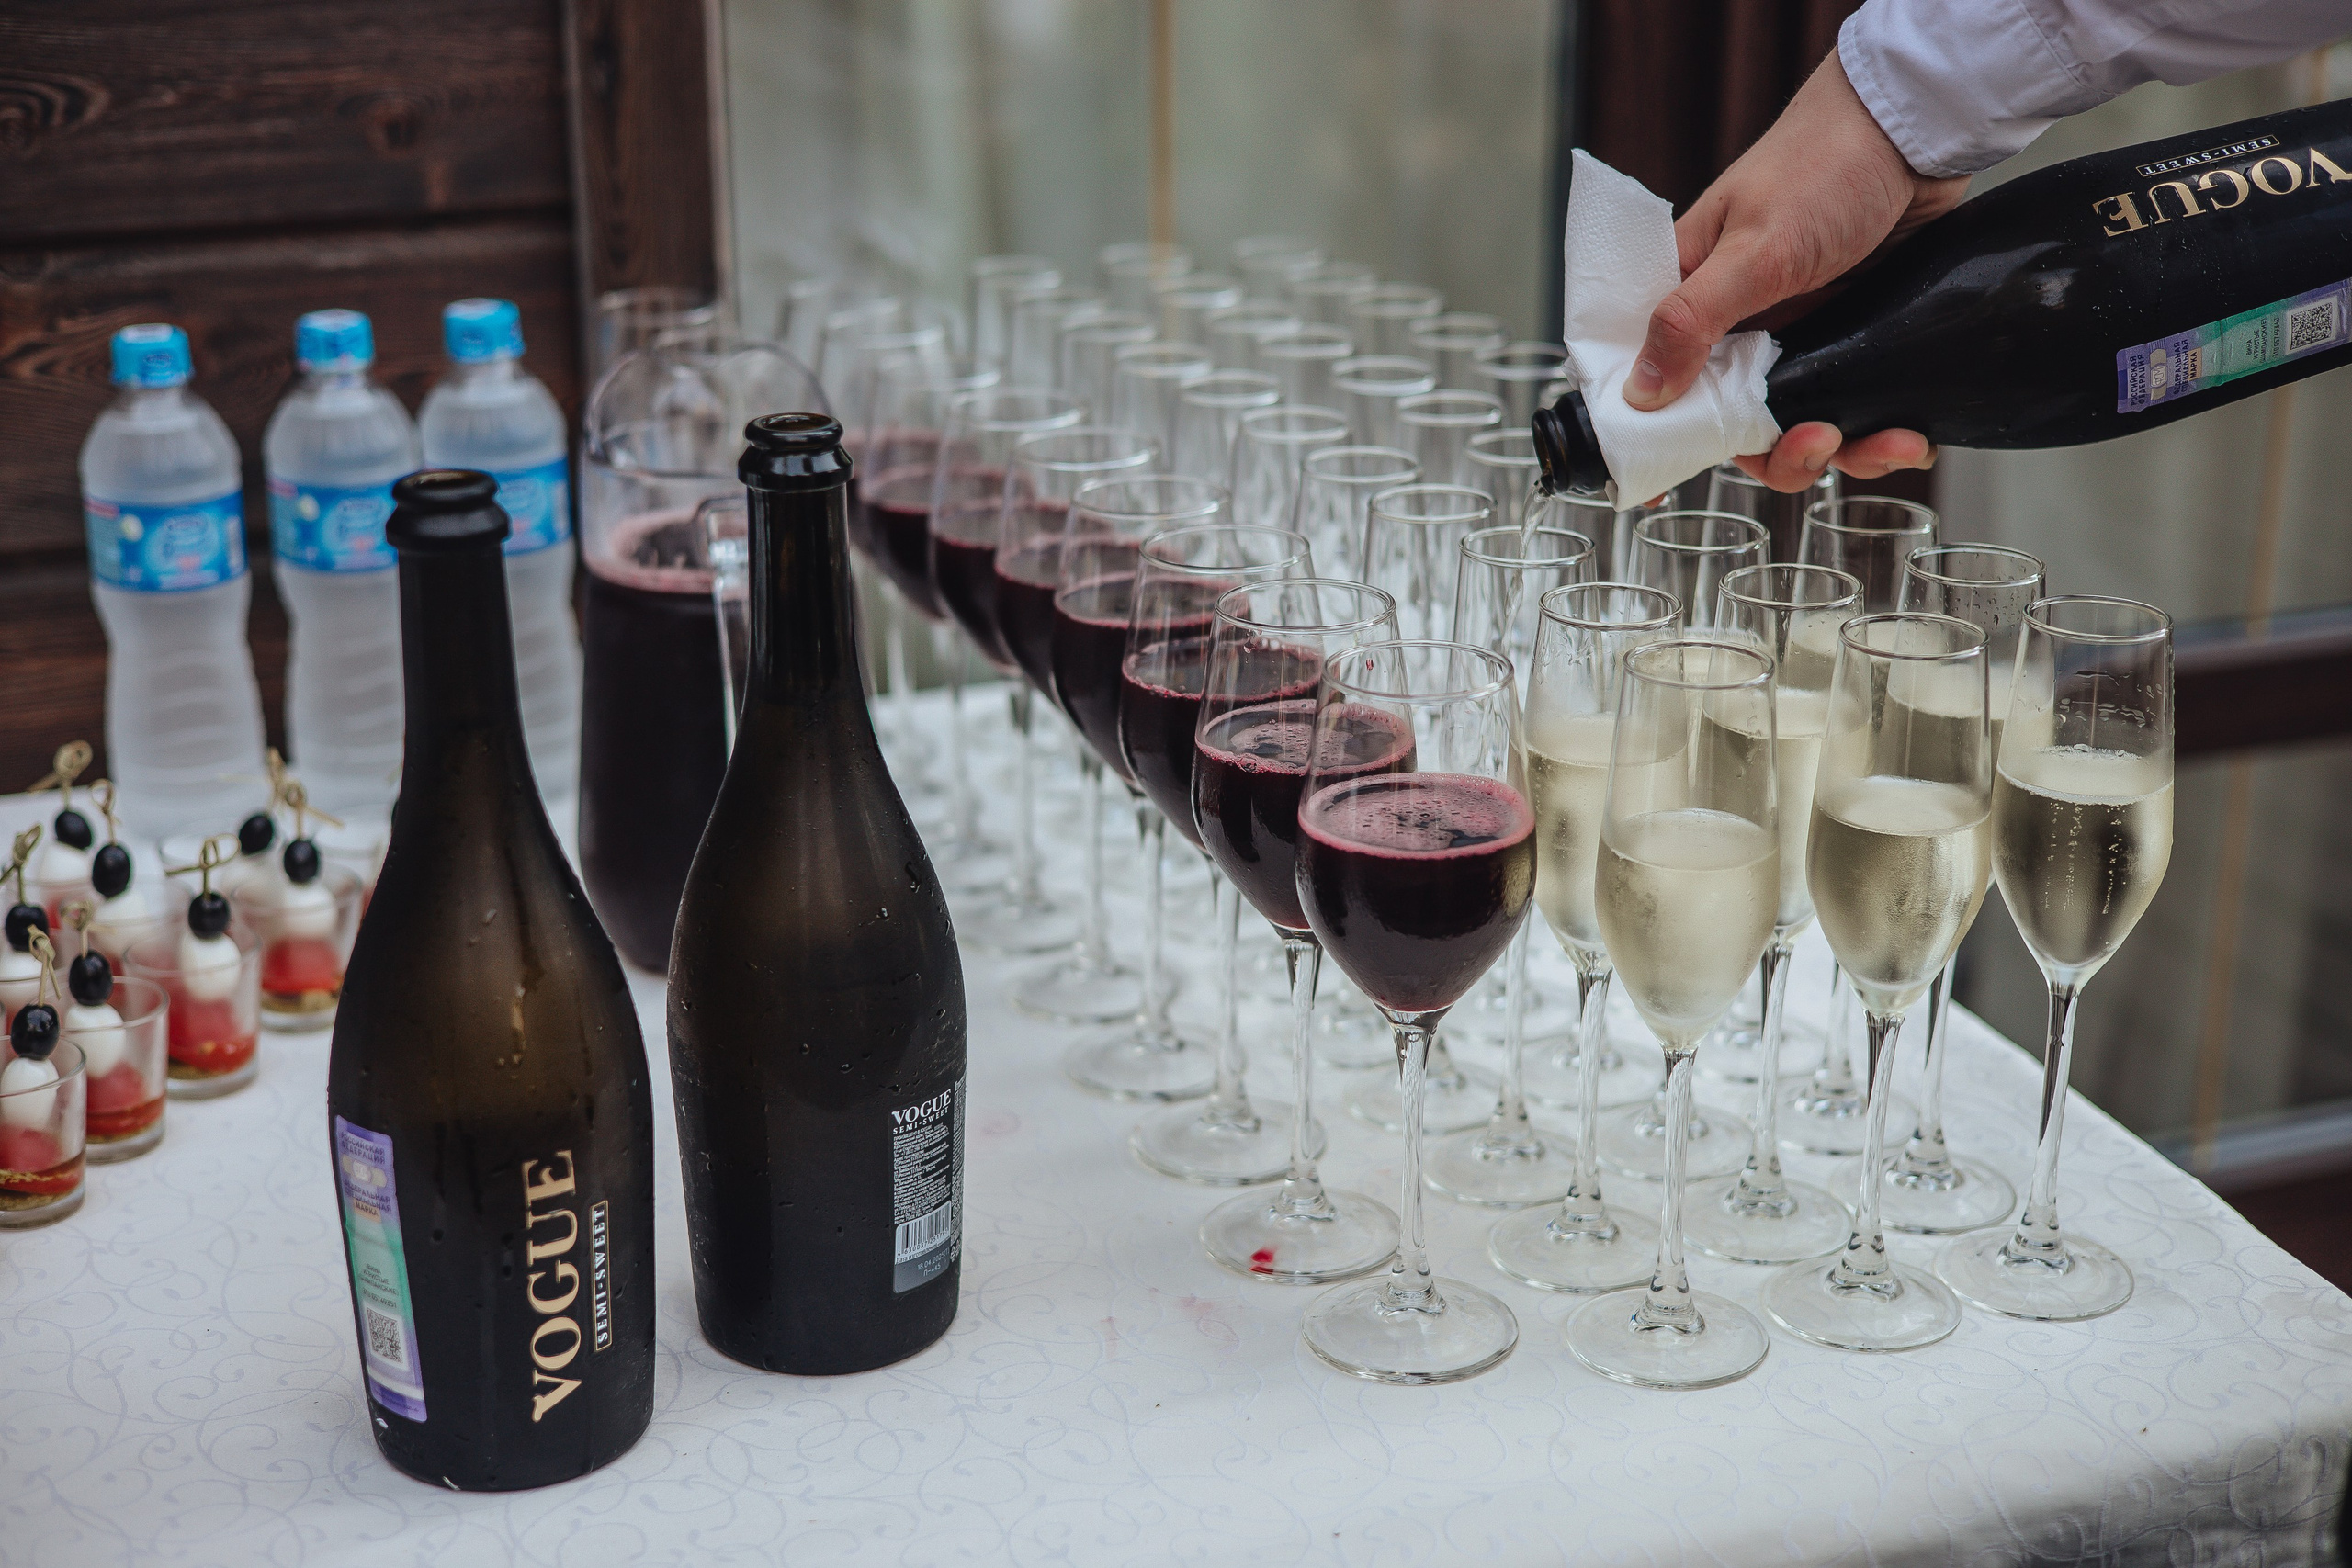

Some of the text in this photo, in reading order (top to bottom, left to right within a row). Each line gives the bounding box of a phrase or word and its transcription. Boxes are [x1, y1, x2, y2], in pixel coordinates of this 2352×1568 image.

[2144, 138, 2271, 175] SEMI-SWEET
[2092, 147, 2352, 237] VOGUE
[2130, 355, 2138, 406] РОССИЙСКАЯ
[2137, 354, 2146, 404] ФЕДЕРАЦИЯ
[2173, 341, 2181, 394] ФЕДЕРАЛЬНАЯ
[2181, 339, 2189, 393] СПЕЦИАЛЬНАЯ
[891, 1089, 952, 1126] VOGUE
[892, 1106, 950, 1135] SEMI-SWEET
[356, 1201, 379, 1216] МАРКА
[522, 1149, 582, 1423] VOGUE
[593, 1210, 609, 1343] SEMI-SWEET
